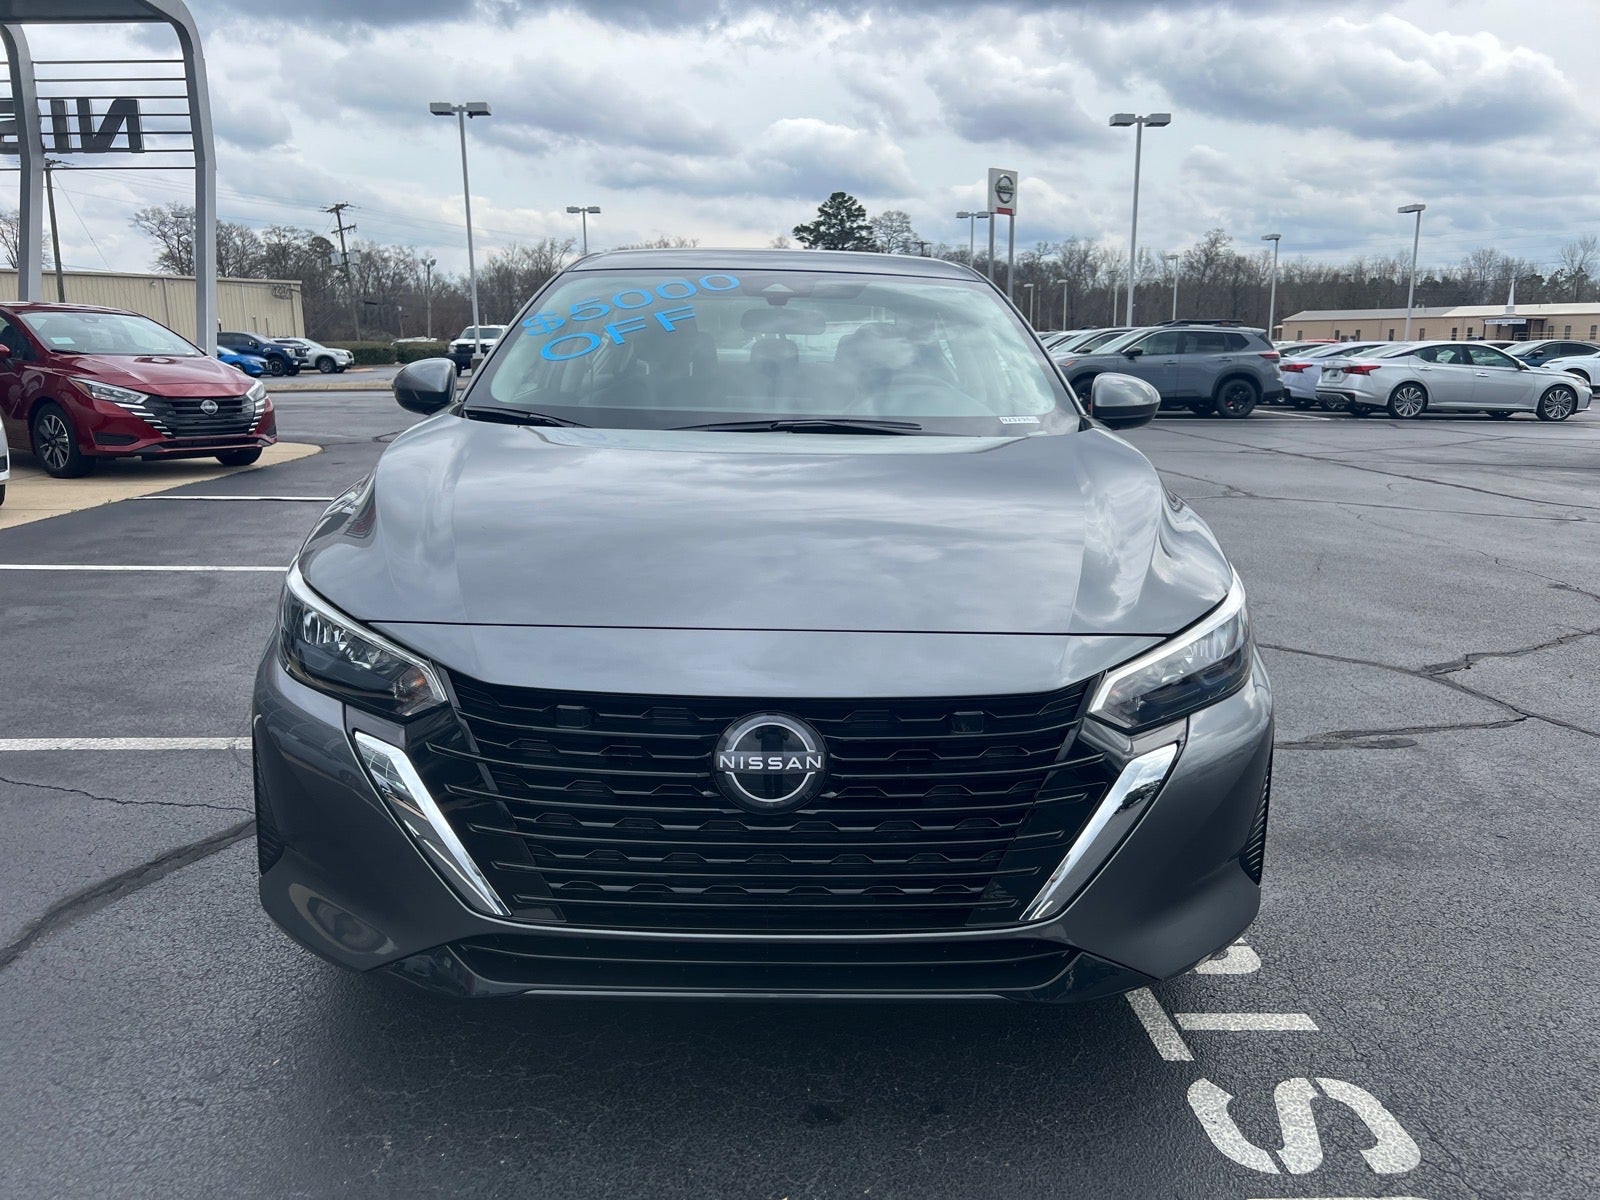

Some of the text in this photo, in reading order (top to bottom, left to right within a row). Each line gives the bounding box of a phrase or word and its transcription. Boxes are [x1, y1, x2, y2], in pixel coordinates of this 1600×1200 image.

[522, 273, 740, 336] $5000
[540, 305, 696, 361] OFF
[719, 755, 822, 770] NISSAN
